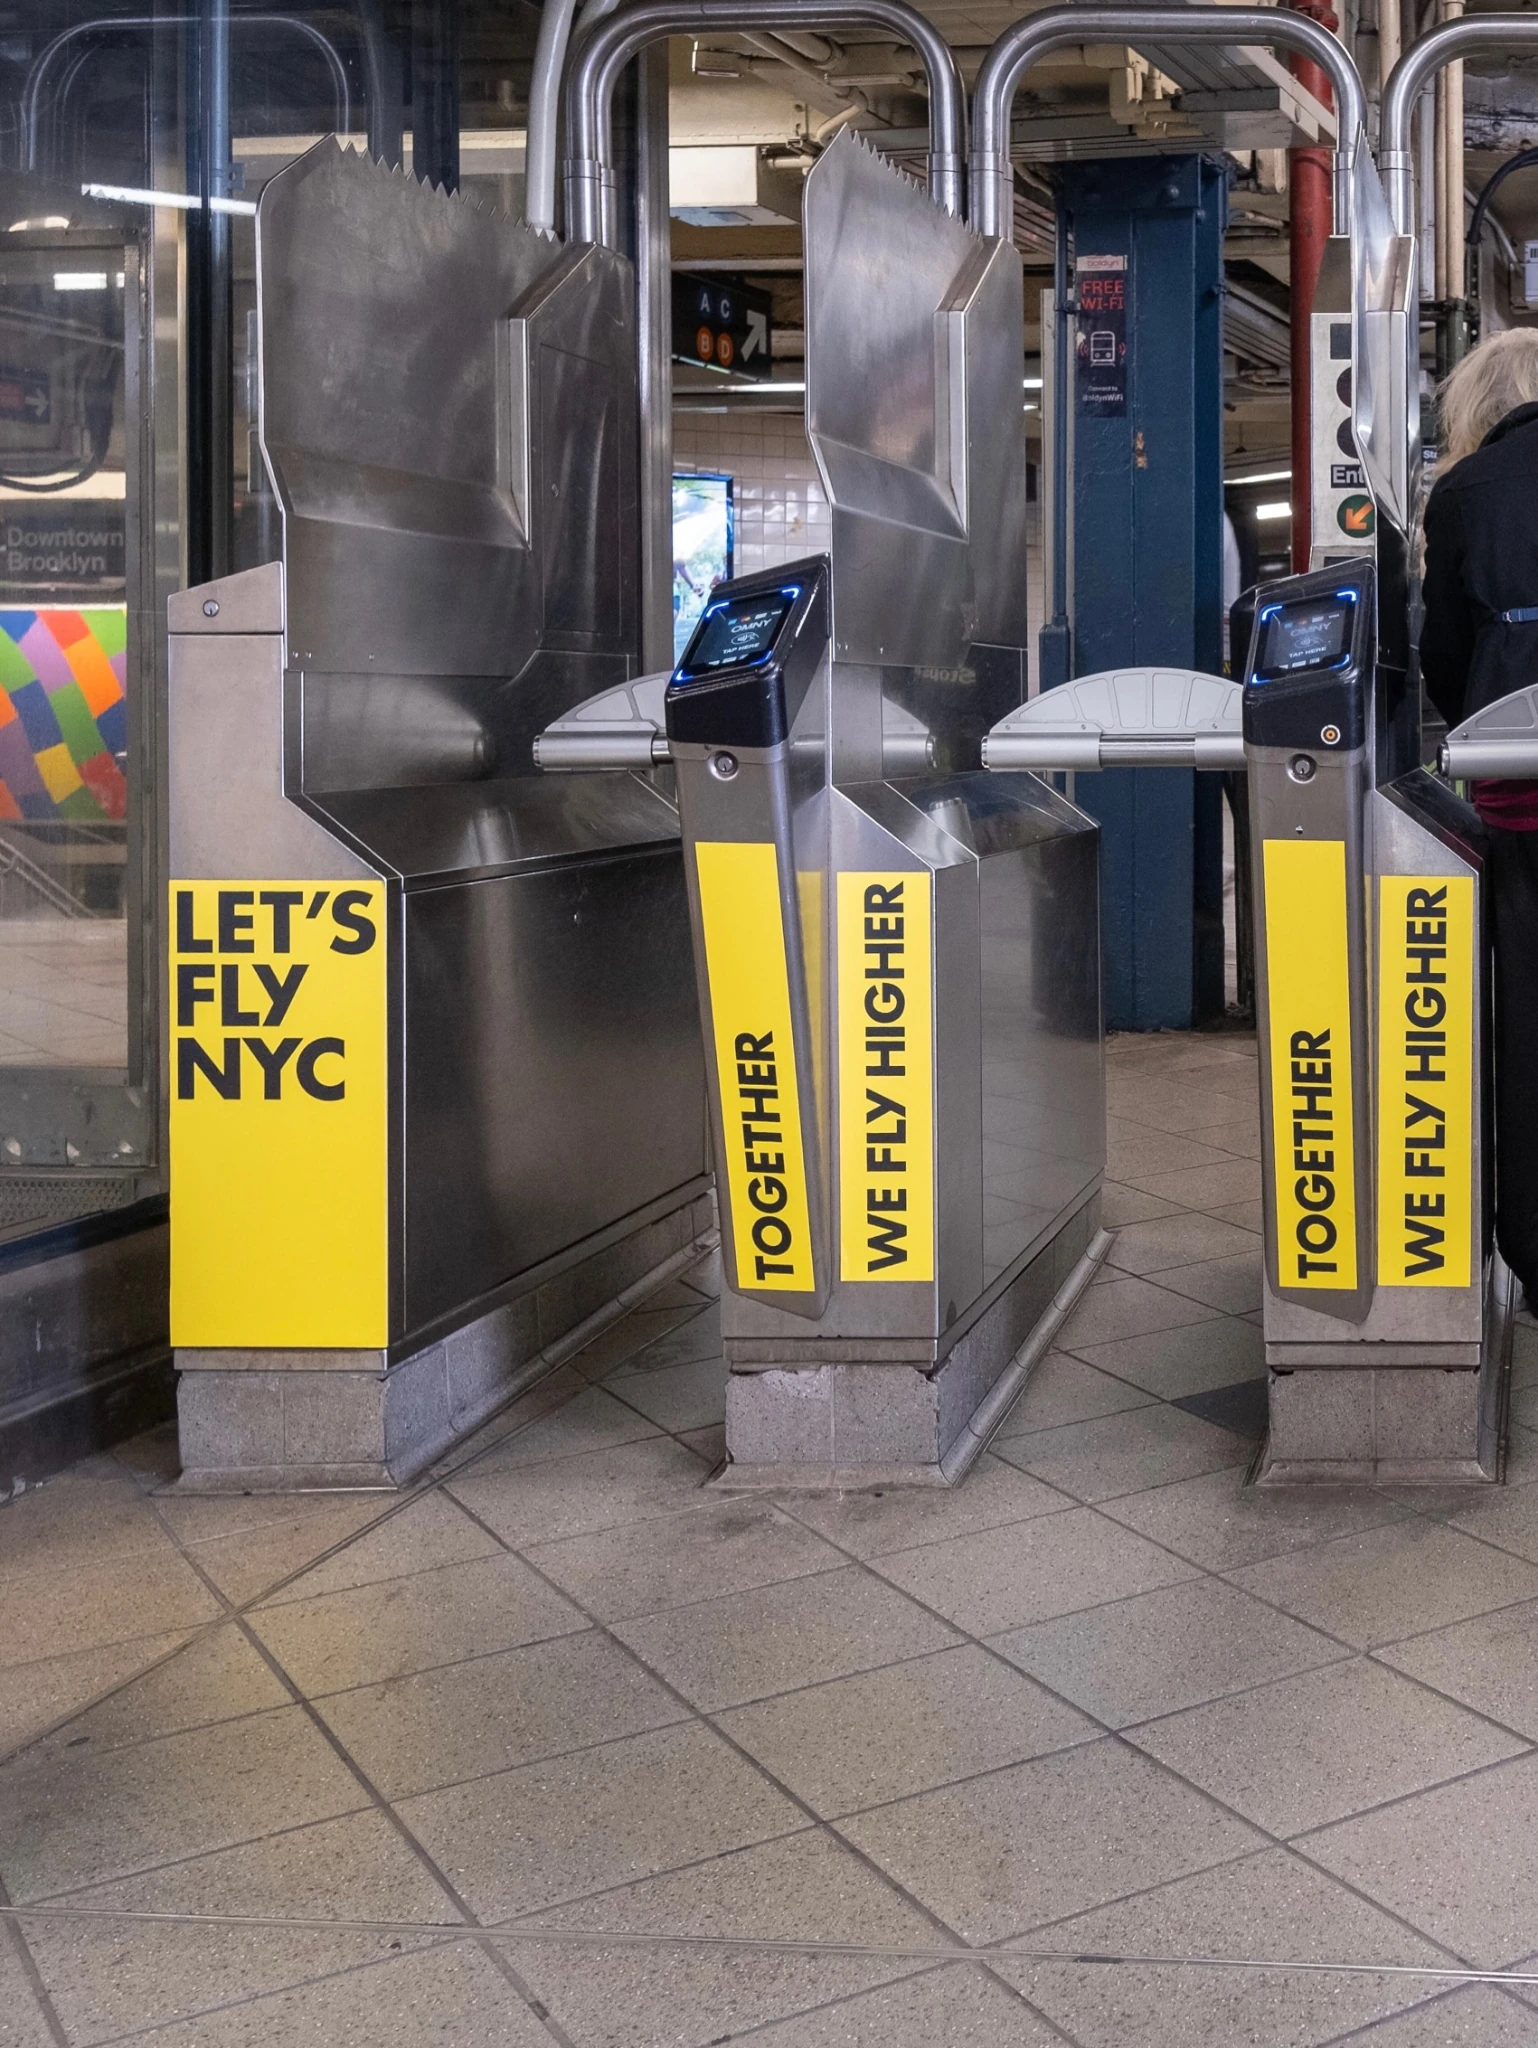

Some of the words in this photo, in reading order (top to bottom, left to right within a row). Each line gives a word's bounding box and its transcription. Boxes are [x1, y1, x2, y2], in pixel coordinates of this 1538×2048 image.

[700, 292, 711, 313] A
[720, 299, 730, 319] C
[1081, 280, 1124, 294] FREE
[1081, 297, 1124, 311] WI-FI
[701, 334, 709, 353] B
[721, 340, 730, 359] D
[7, 526, 124, 548] Downtown
[7, 550, 106, 576] Brooklyn
[731, 618, 772, 633] OMNY
[738, 642, 760, 651] HERE
[1290, 621, 1332, 636] OMNY
[1305, 646, 1327, 654] HERE
[176, 889, 377, 955] LET'S
[177, 964, 309, 1027] FLY
[864, 880, 906, 1077] HIGHER
[1404, 885, 1448, 1082] HIGHER
[177, 1036, 345, 1102] NYC
[734, 1030, 795, 1281] TOGETHER
[865, 1088, 907, 1172] FLY
[1291, 1028, 1338, 1278] TOGETHER
[1404, 1092, 1446, 1177] FLY
[866, 1187, 908, 1272] WE
[1404, 1193, 1445, 1278] WE
